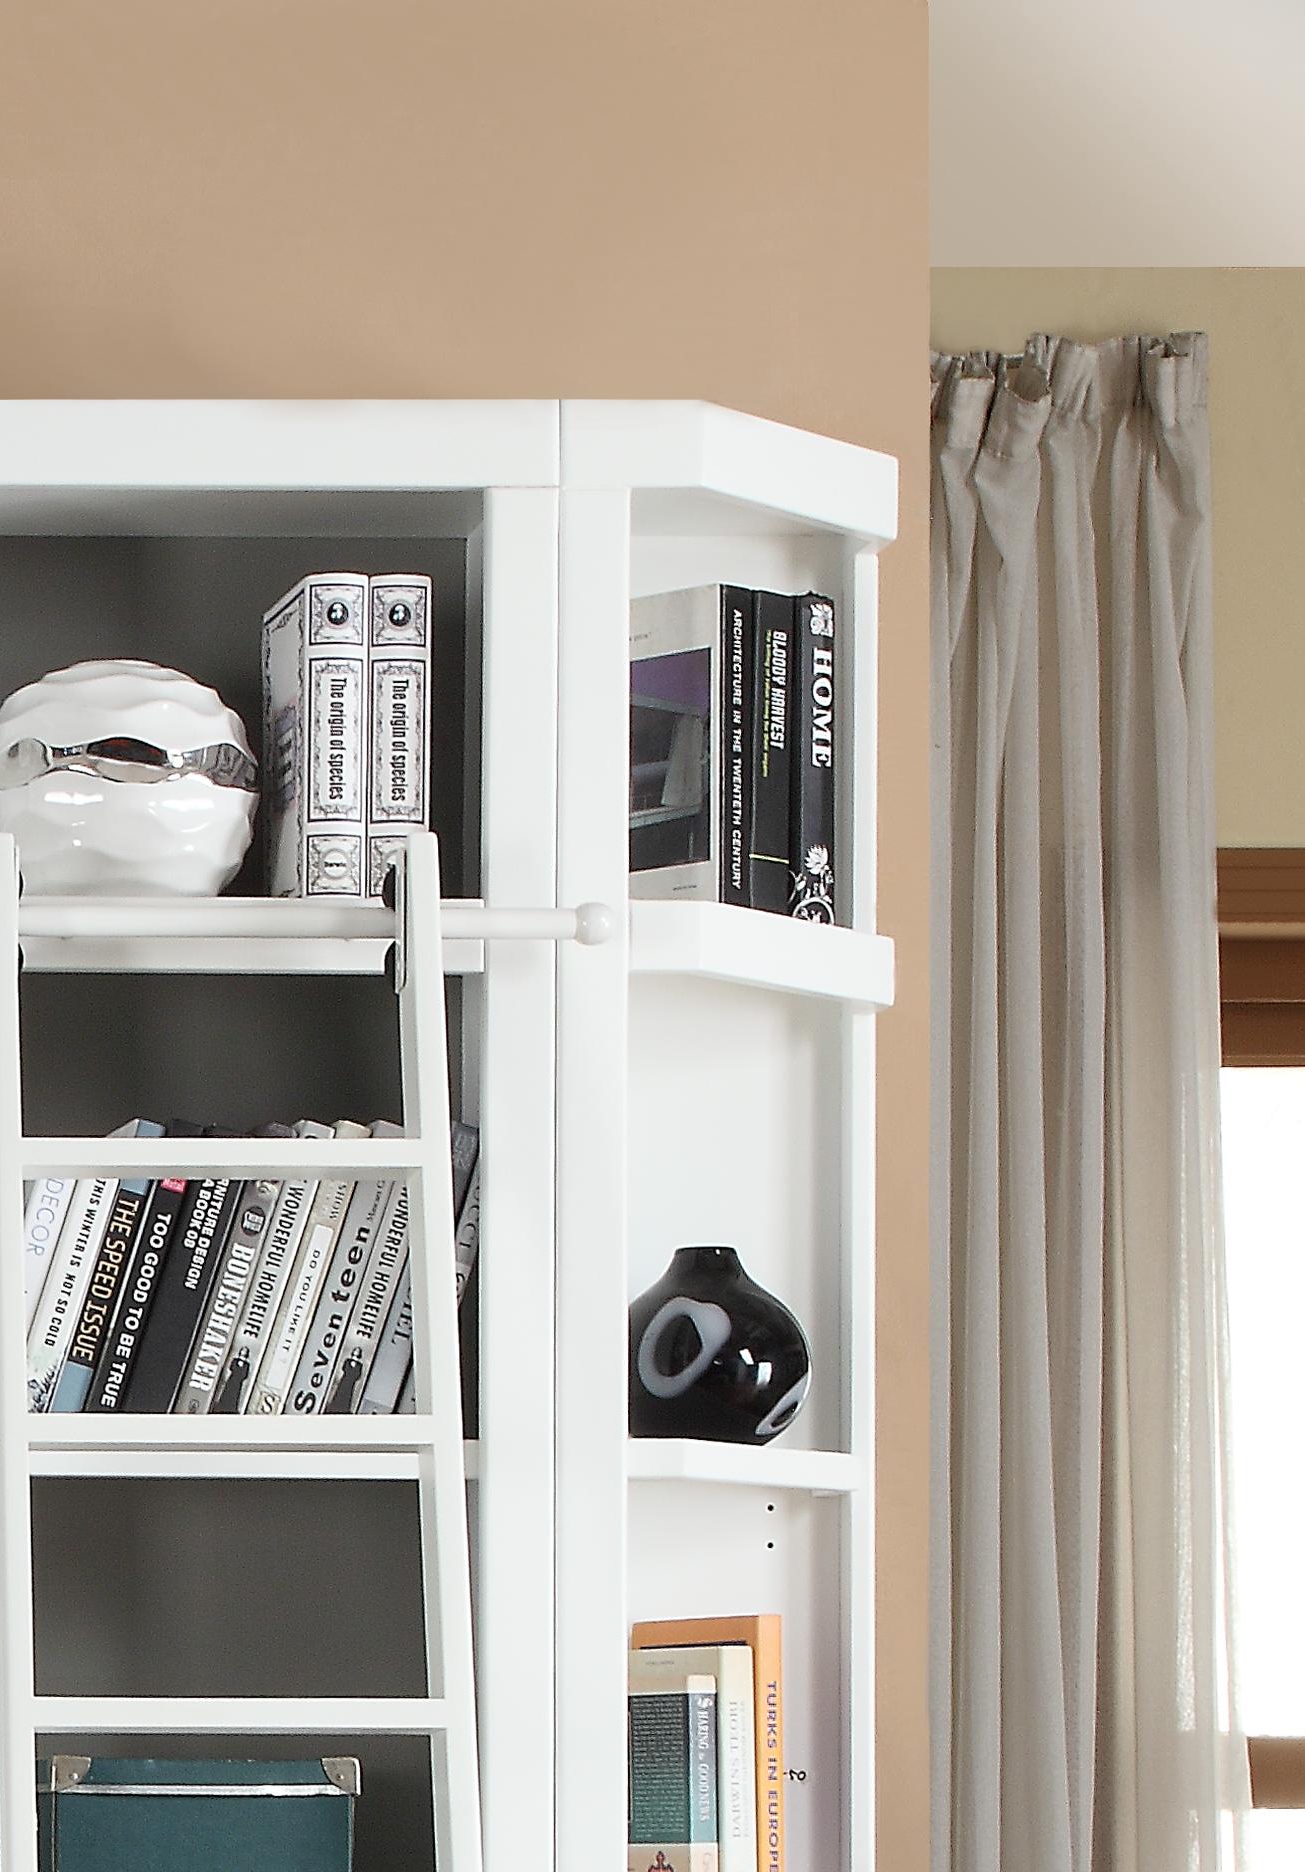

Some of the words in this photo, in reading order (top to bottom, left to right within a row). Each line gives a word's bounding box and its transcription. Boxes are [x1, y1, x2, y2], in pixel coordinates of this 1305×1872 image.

[733, 609, 742, 706] ARCHITECTURE
[771, 630, 787, 686] BLOODY
[330, 678, 347, 699] The
[392, 679, 409, 700] The
[812, 647, 833, 767] HOME
[328, 701, 347, 736] origin
[390, 703, 409, 738] origin
[733, 728, 742, 753] THE
[770, 687, 786, 750] HARVEST
[330, 740, 346, 751] of
[392, 741, 409, 752] of
[328, 753, 346, 800] species
[390, 755, 408, 801] species
[732, 829, 741, 890] CENTURY
[90, 1179, 107, 1206] THIS
[189, 1186, 212, 1232] BOOK
[204, 1178, 230, 1243] RNITURE
[27, 1178, 64, 1257] DECOR
[74, 1208, 97, 1253] WINTER
[110, 1198, 140, 1238] THE
[149, 1213, 172, 1249] TOO
[268, 1186, 305, 1268] WONDERFUL
[70, 1255, 83, 1268] IS
[91, 1237, 127, 1300] SPEED
[133, 1252, 160, 1304] GOOD
[184, 1238, 210, 1290] DESIGN
[55, 1298, 69, 1315] SO
[124, 1307, 144, 1331] TO
[189, 1243, 256, 1392] BONESHAKER
[243, 1271, 277, 1339] HOMELIFE
[357, 1271, 390, 1339] HOMELIFE
[44, 1317, 63, 1347] COLD
[72, 1300, 107, 1362] ISSUE
[115, 1333, 135, 1359] BE
[101, 1362, 127, 1408] TRUE
[294, 1313, 343, 1414] Seven
[767, 1681, 778, 1749] TURKS
[768, 1757, 778, 1781] IN
